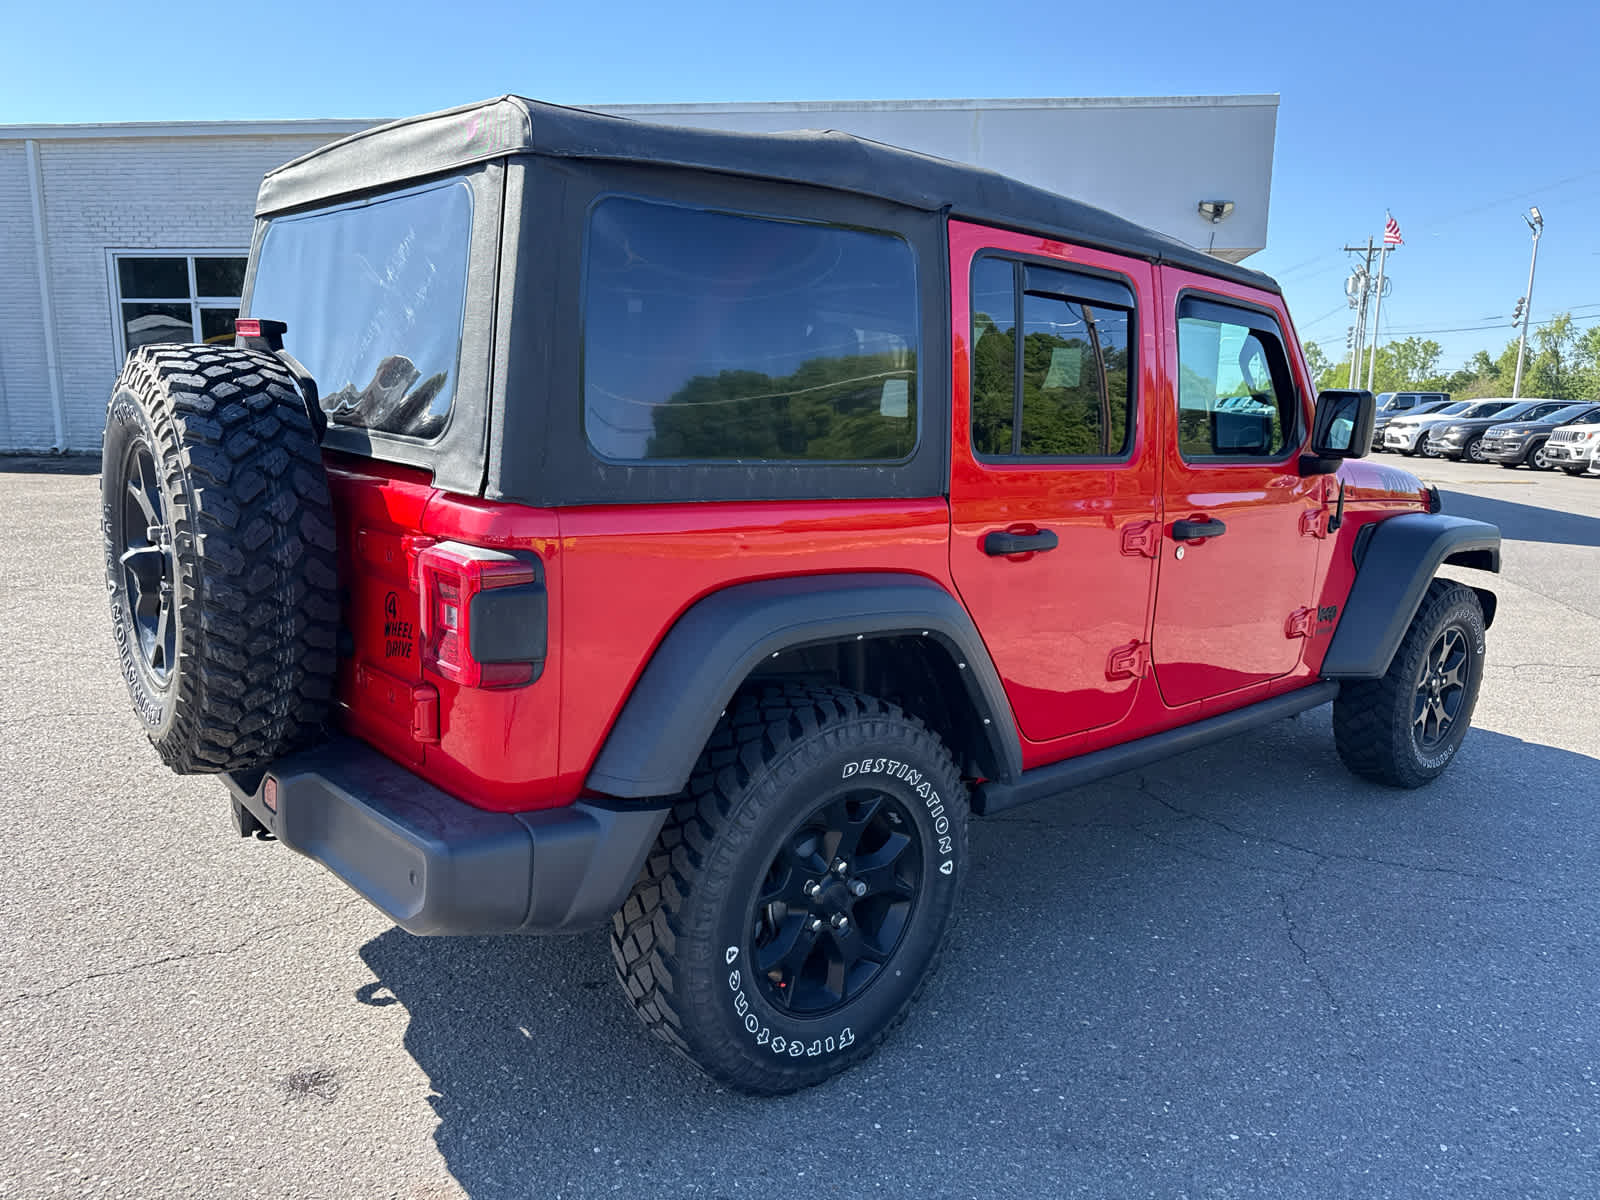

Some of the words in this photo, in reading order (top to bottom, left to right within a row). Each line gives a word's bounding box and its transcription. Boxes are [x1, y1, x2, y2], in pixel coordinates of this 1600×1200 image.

[384, 621, 413, 639] WHEEL
[385, 640, 413, 658] DRIVE
[842, 758, 952, 854] DESTINATION
